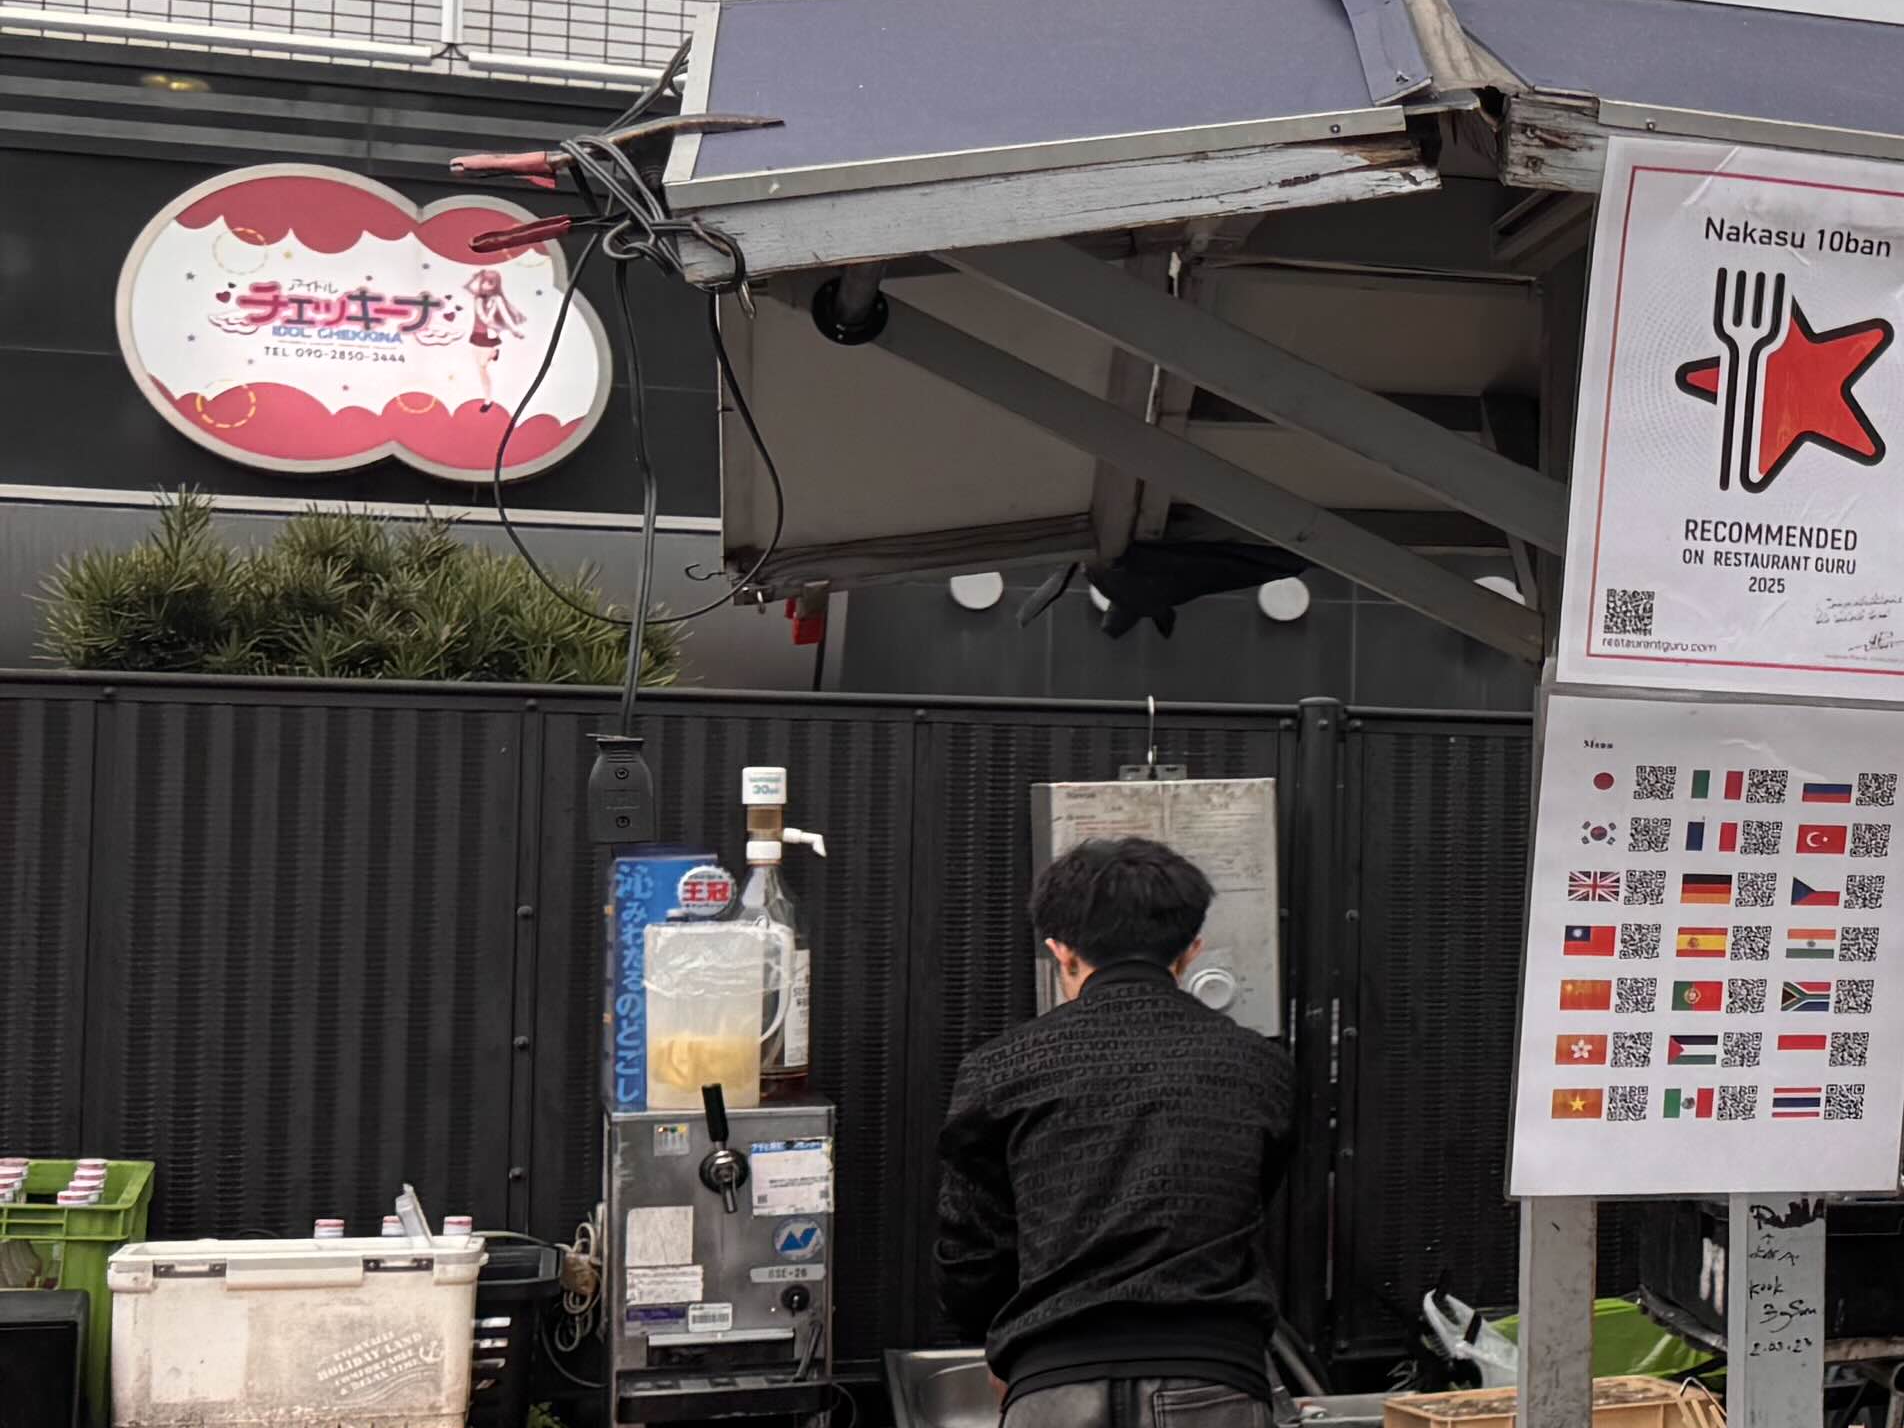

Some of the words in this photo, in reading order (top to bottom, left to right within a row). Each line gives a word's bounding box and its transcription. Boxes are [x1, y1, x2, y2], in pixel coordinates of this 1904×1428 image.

[1704, 216, 1805, 249] Nakasu
[1817, 228, 1891, 258] 10ban
[237, 281, 443, 332] チェッキーナ
[264, 346, 289, 357] TEL
[1684, 519, 1857, 551] RECOMMENDED
[1682, 549, 1704, 565] ON
[1713, 551, 1811, 573] RESTAURANT
[1815, 556, 1857, 575] GURU
[1748, 576, 1786, 594] 2025
